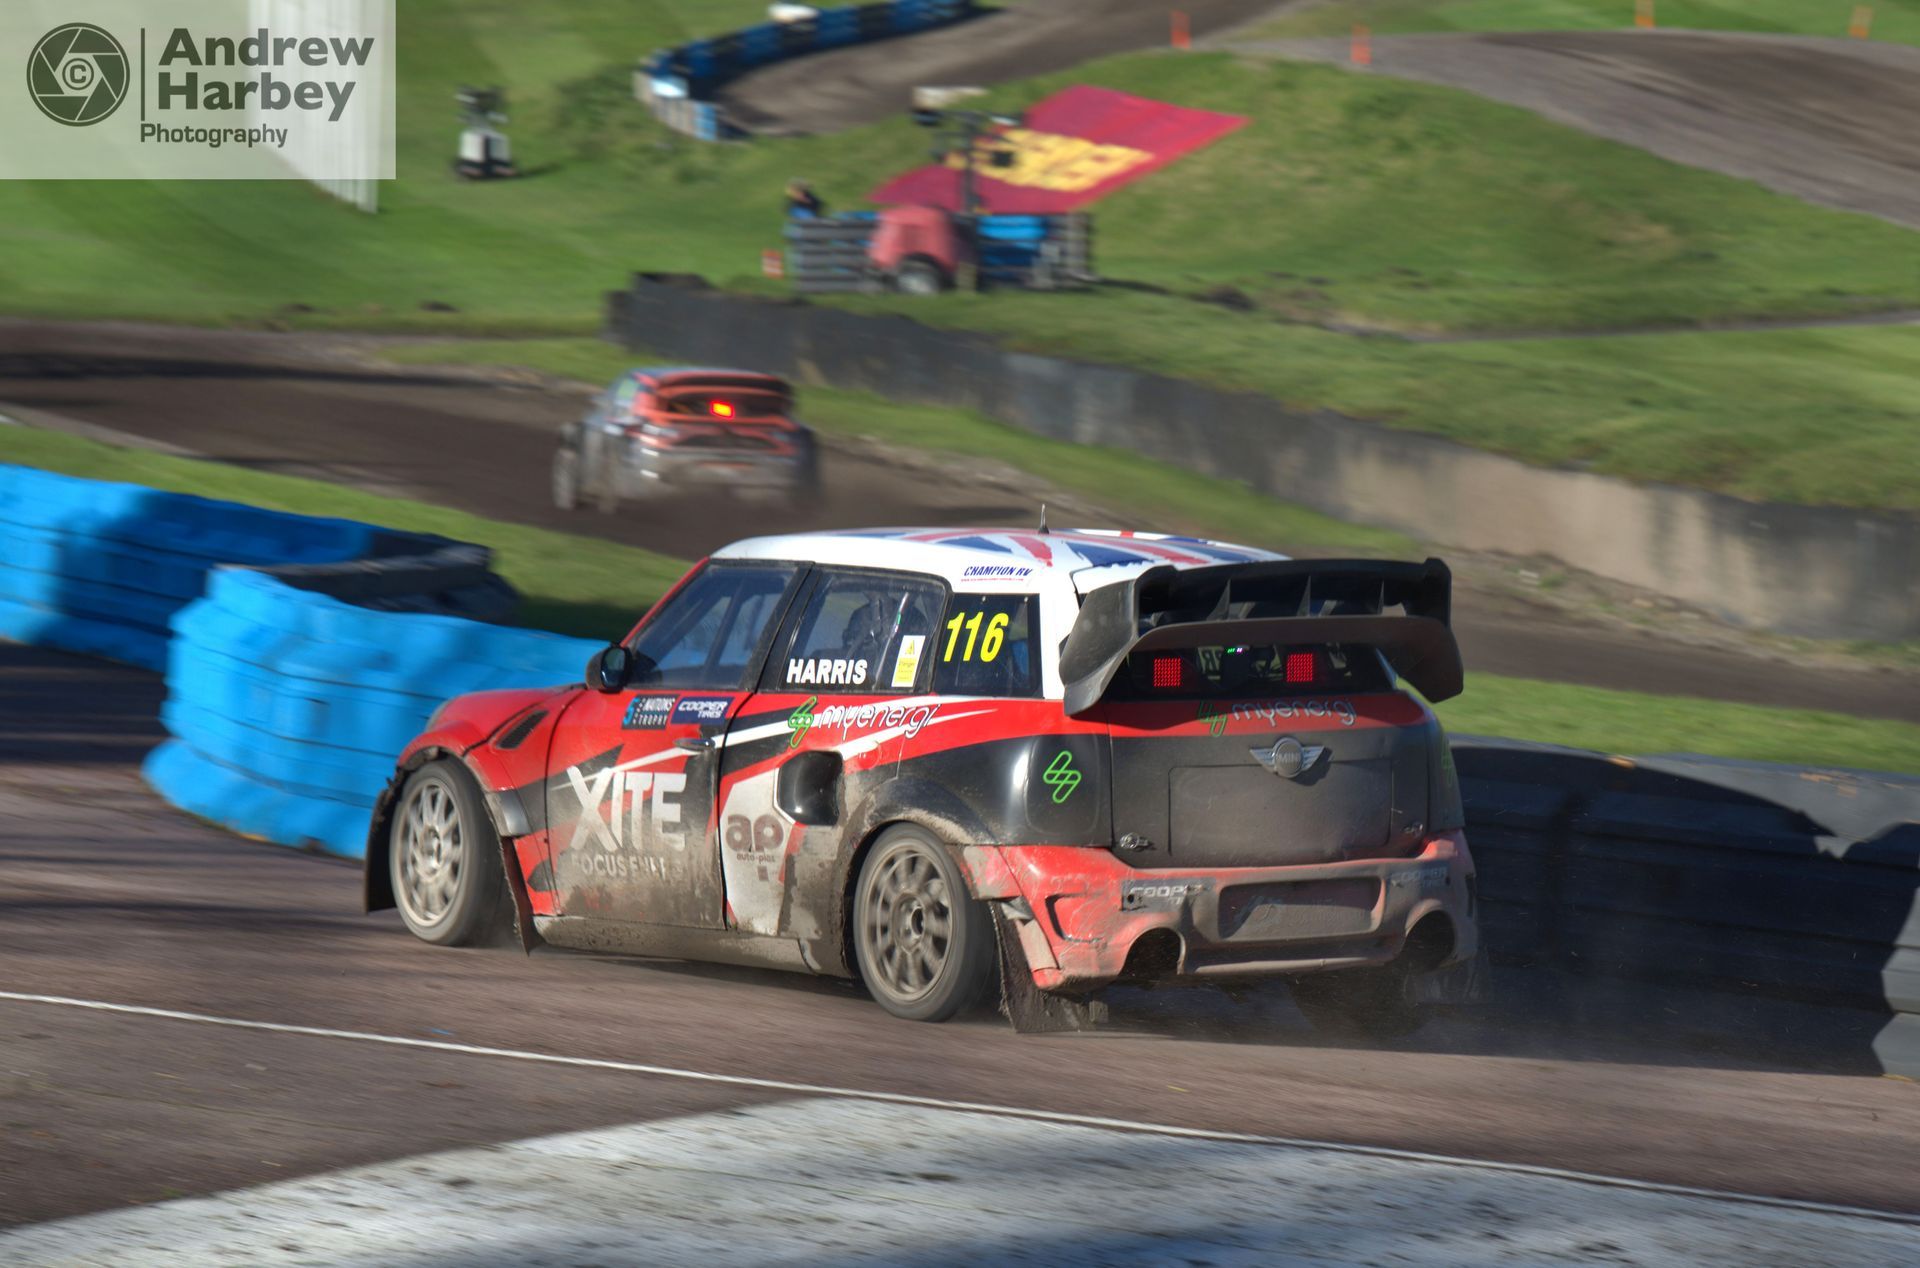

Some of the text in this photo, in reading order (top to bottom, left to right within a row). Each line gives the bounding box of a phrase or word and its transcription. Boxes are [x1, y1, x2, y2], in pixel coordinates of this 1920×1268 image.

[964, 566, 1016, 576] CHAMPION
[943, 612, 1009, 663] 116
[786, 658, 868, 685] HARRIS
[678, 701, 728, 711] COOPER
[818, 703, 942, 741] myenergi
[567, 765, 687, 851] XITE
